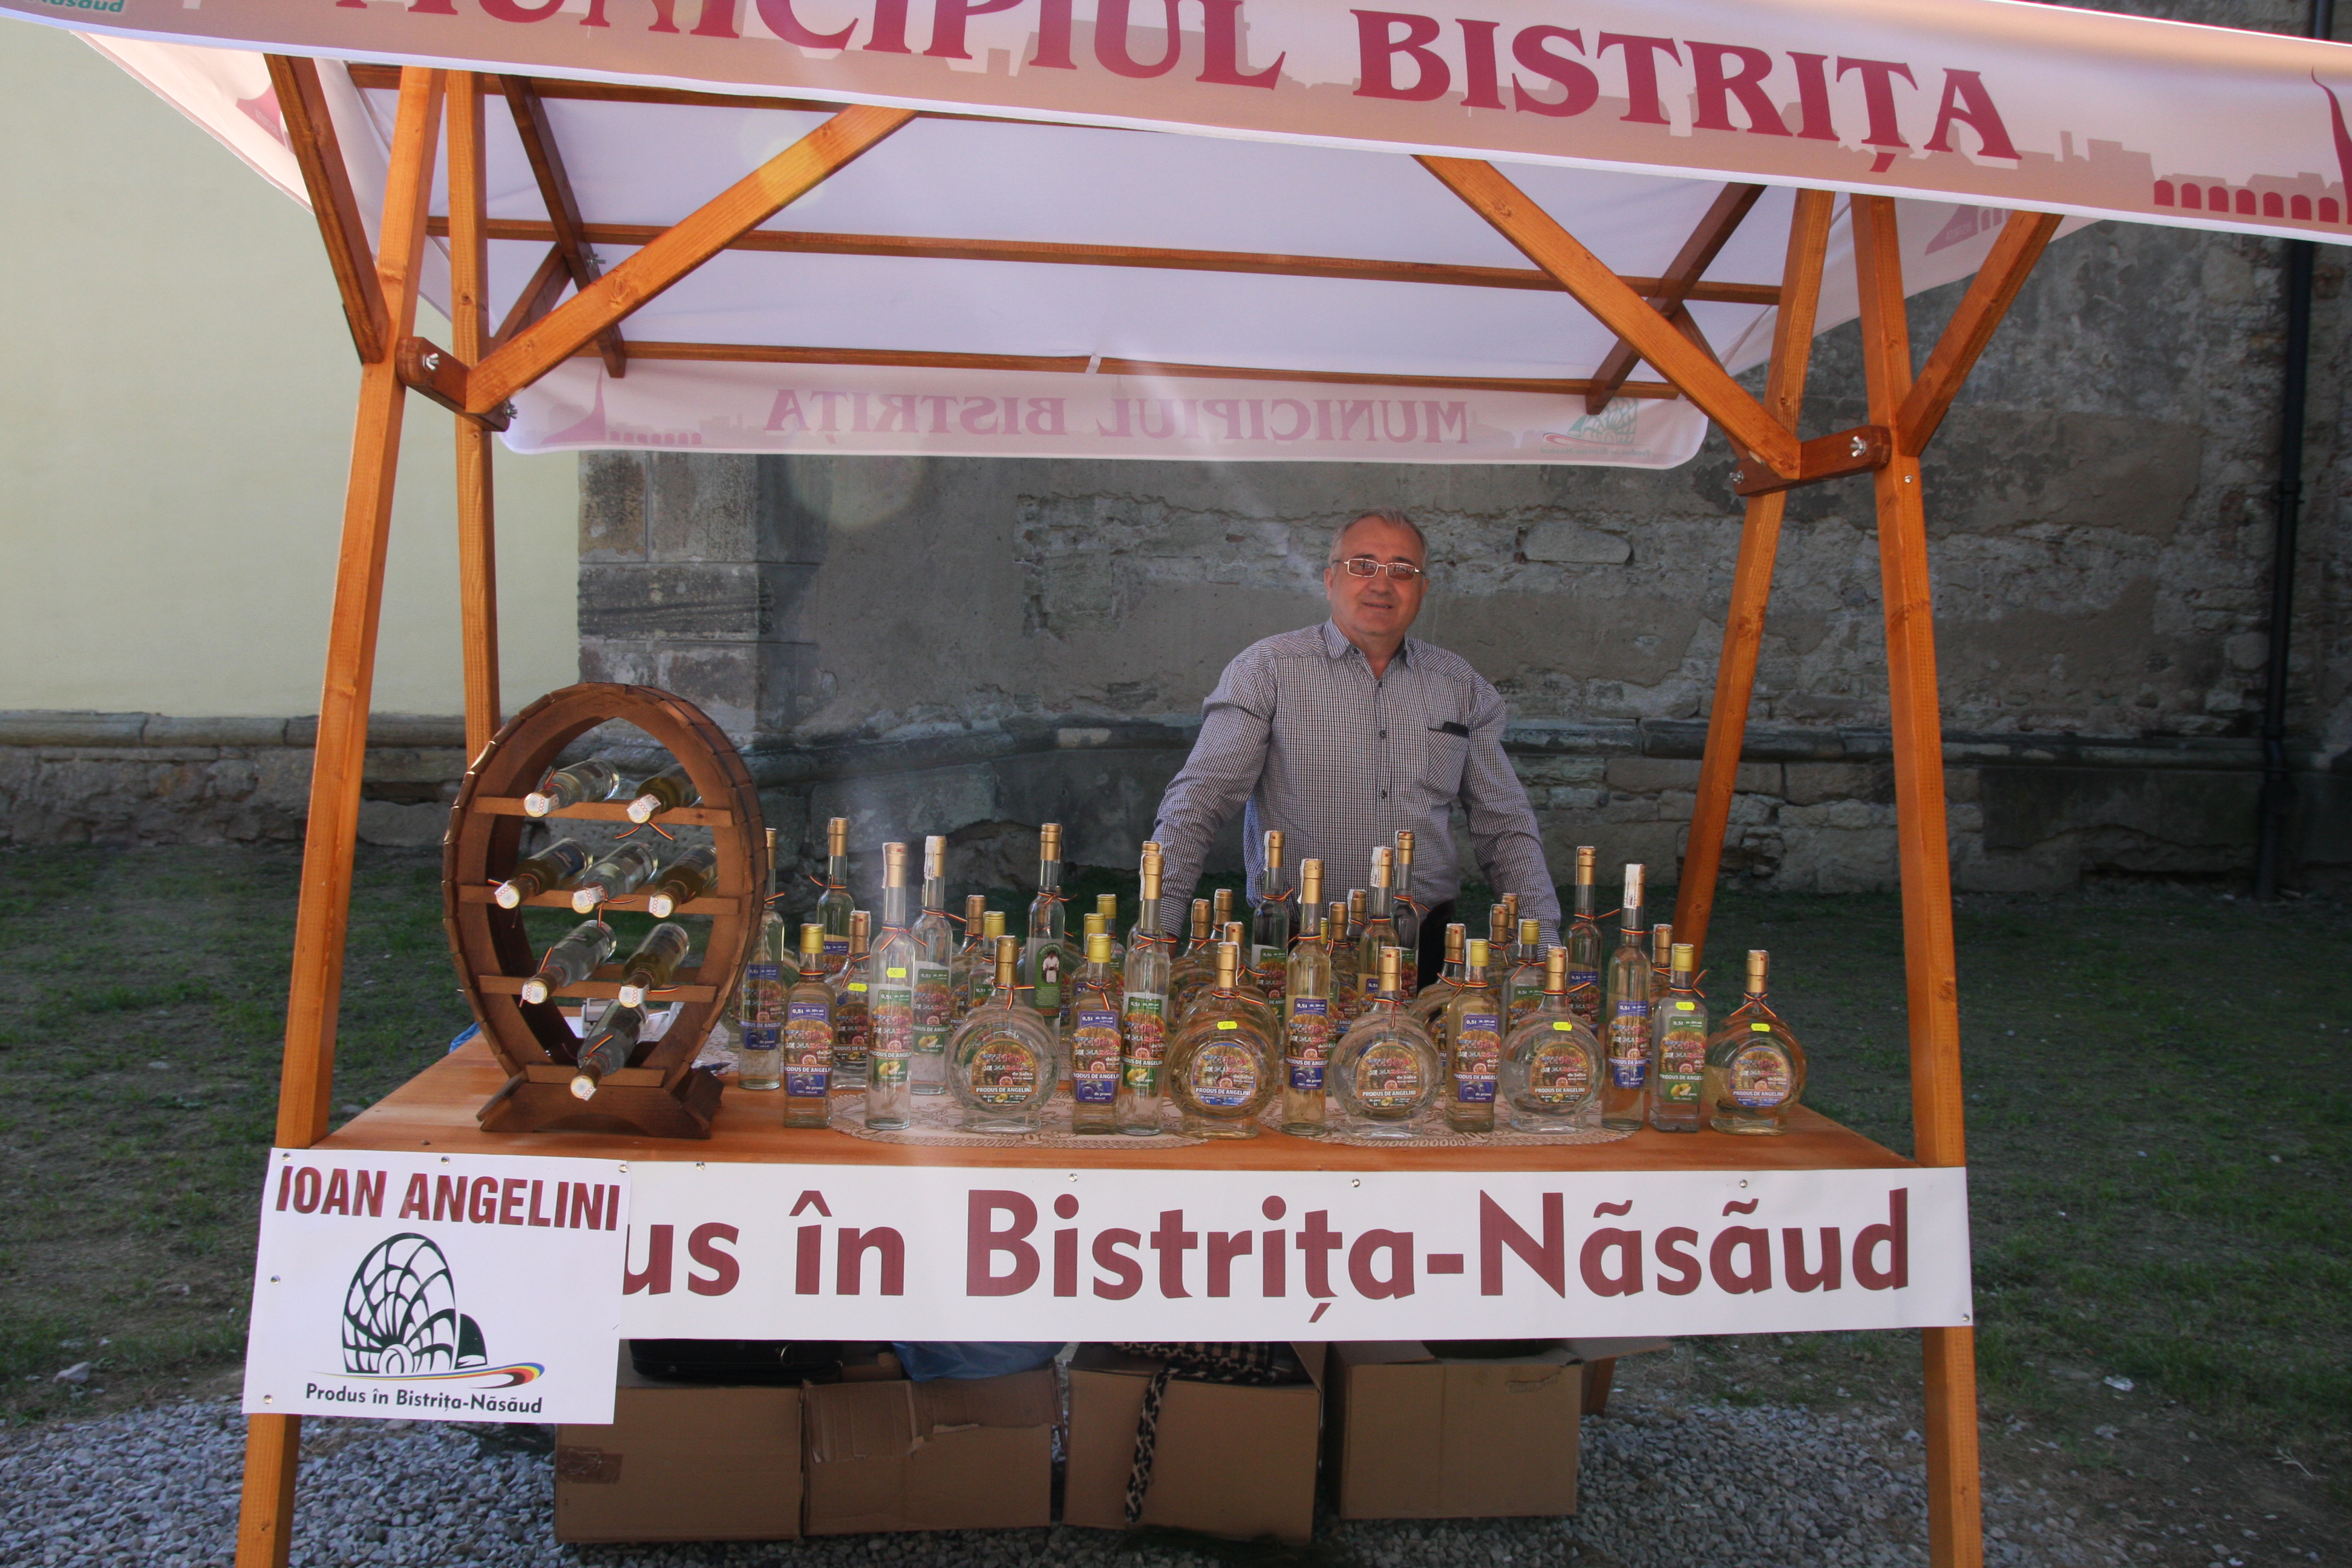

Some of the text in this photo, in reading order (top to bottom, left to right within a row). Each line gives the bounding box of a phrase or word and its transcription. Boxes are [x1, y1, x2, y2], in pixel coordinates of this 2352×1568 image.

[336, 0, 2022, 172] CIPIUL BISTRIȚA
[276, 1165, 621, 1231] IOAN ANGELINI
[789, 1190, 905, 1296] în
[305, 1383, 366, 1404] Produs
[372, 1387, 388, 1405] în
